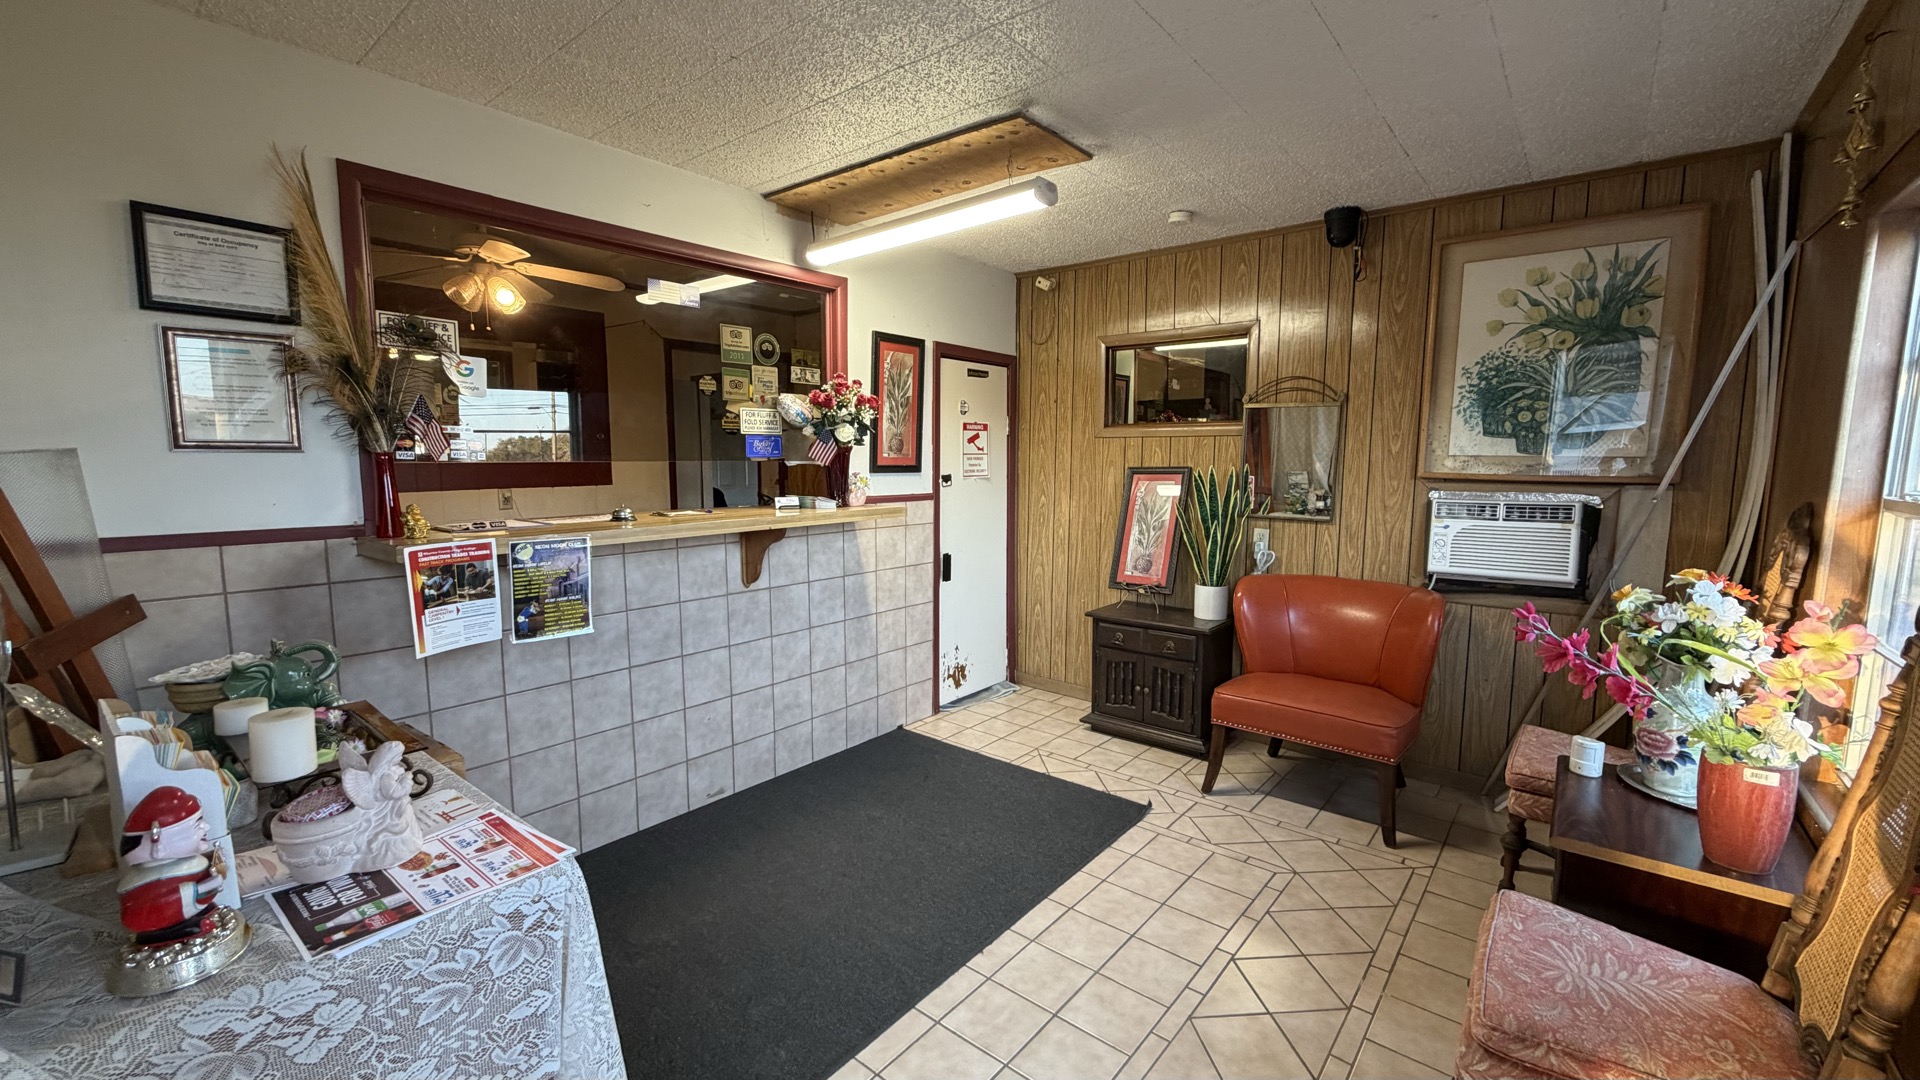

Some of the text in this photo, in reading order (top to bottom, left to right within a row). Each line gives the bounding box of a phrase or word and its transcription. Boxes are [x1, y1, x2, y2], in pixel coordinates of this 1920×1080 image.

[173, 230, 211, 241] Certificate
[221, 238, 258, 250] Occupancy
[441, 323, 449, 332] &
[729, 351, 745, 360] 2011
[418, 554, 451, 562] CONSTRUCTION
[469, 549, 491, 557] TRAINING
[444, 556, 470, 564] PROGRAMS
[428, 607, 449, 615] GENERAL
[428, 609, 454, 619] CARPENTRY
[301, 885, 338, 911] GOING
[336, 886, 368, 906] FOR
